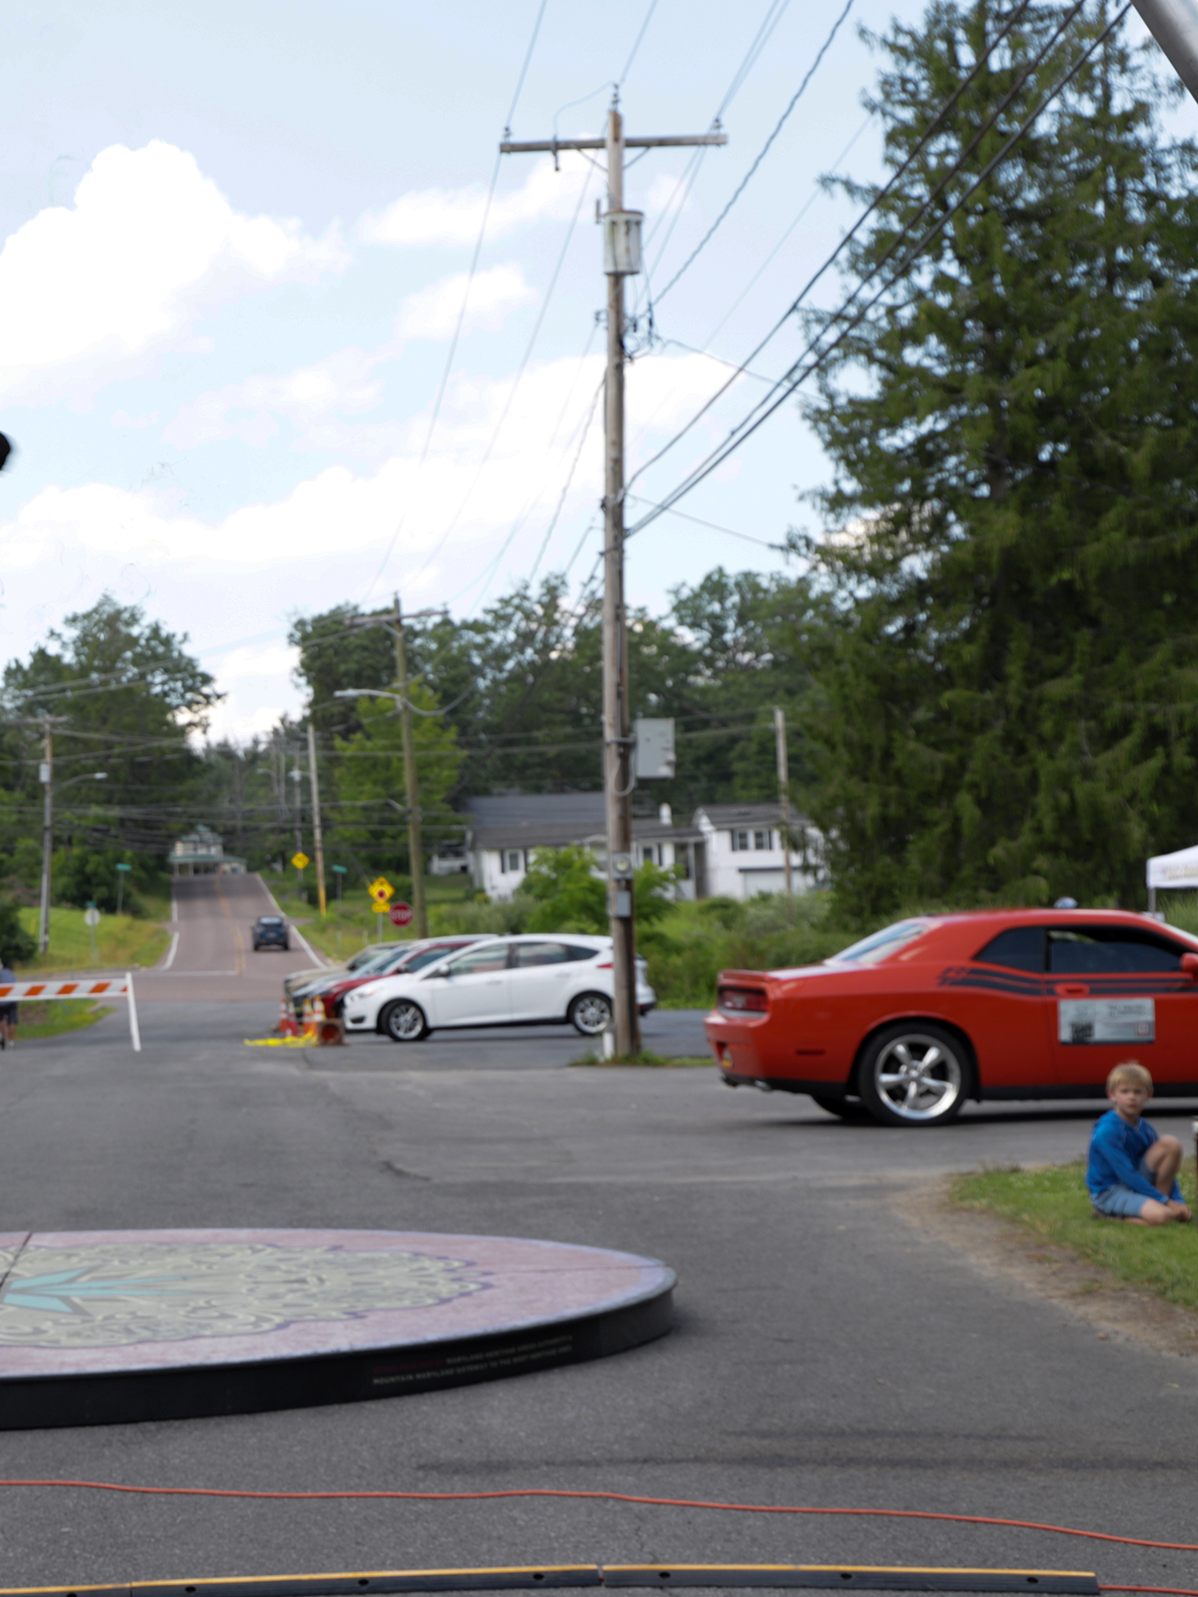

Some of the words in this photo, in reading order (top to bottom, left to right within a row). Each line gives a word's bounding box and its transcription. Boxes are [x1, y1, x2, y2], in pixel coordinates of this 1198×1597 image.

[390, 909, 413, 921] STOP
[372, 1374, 414, 1385] MOUNTAIN
[415, 1367, 455, 1380] MARYLAND
